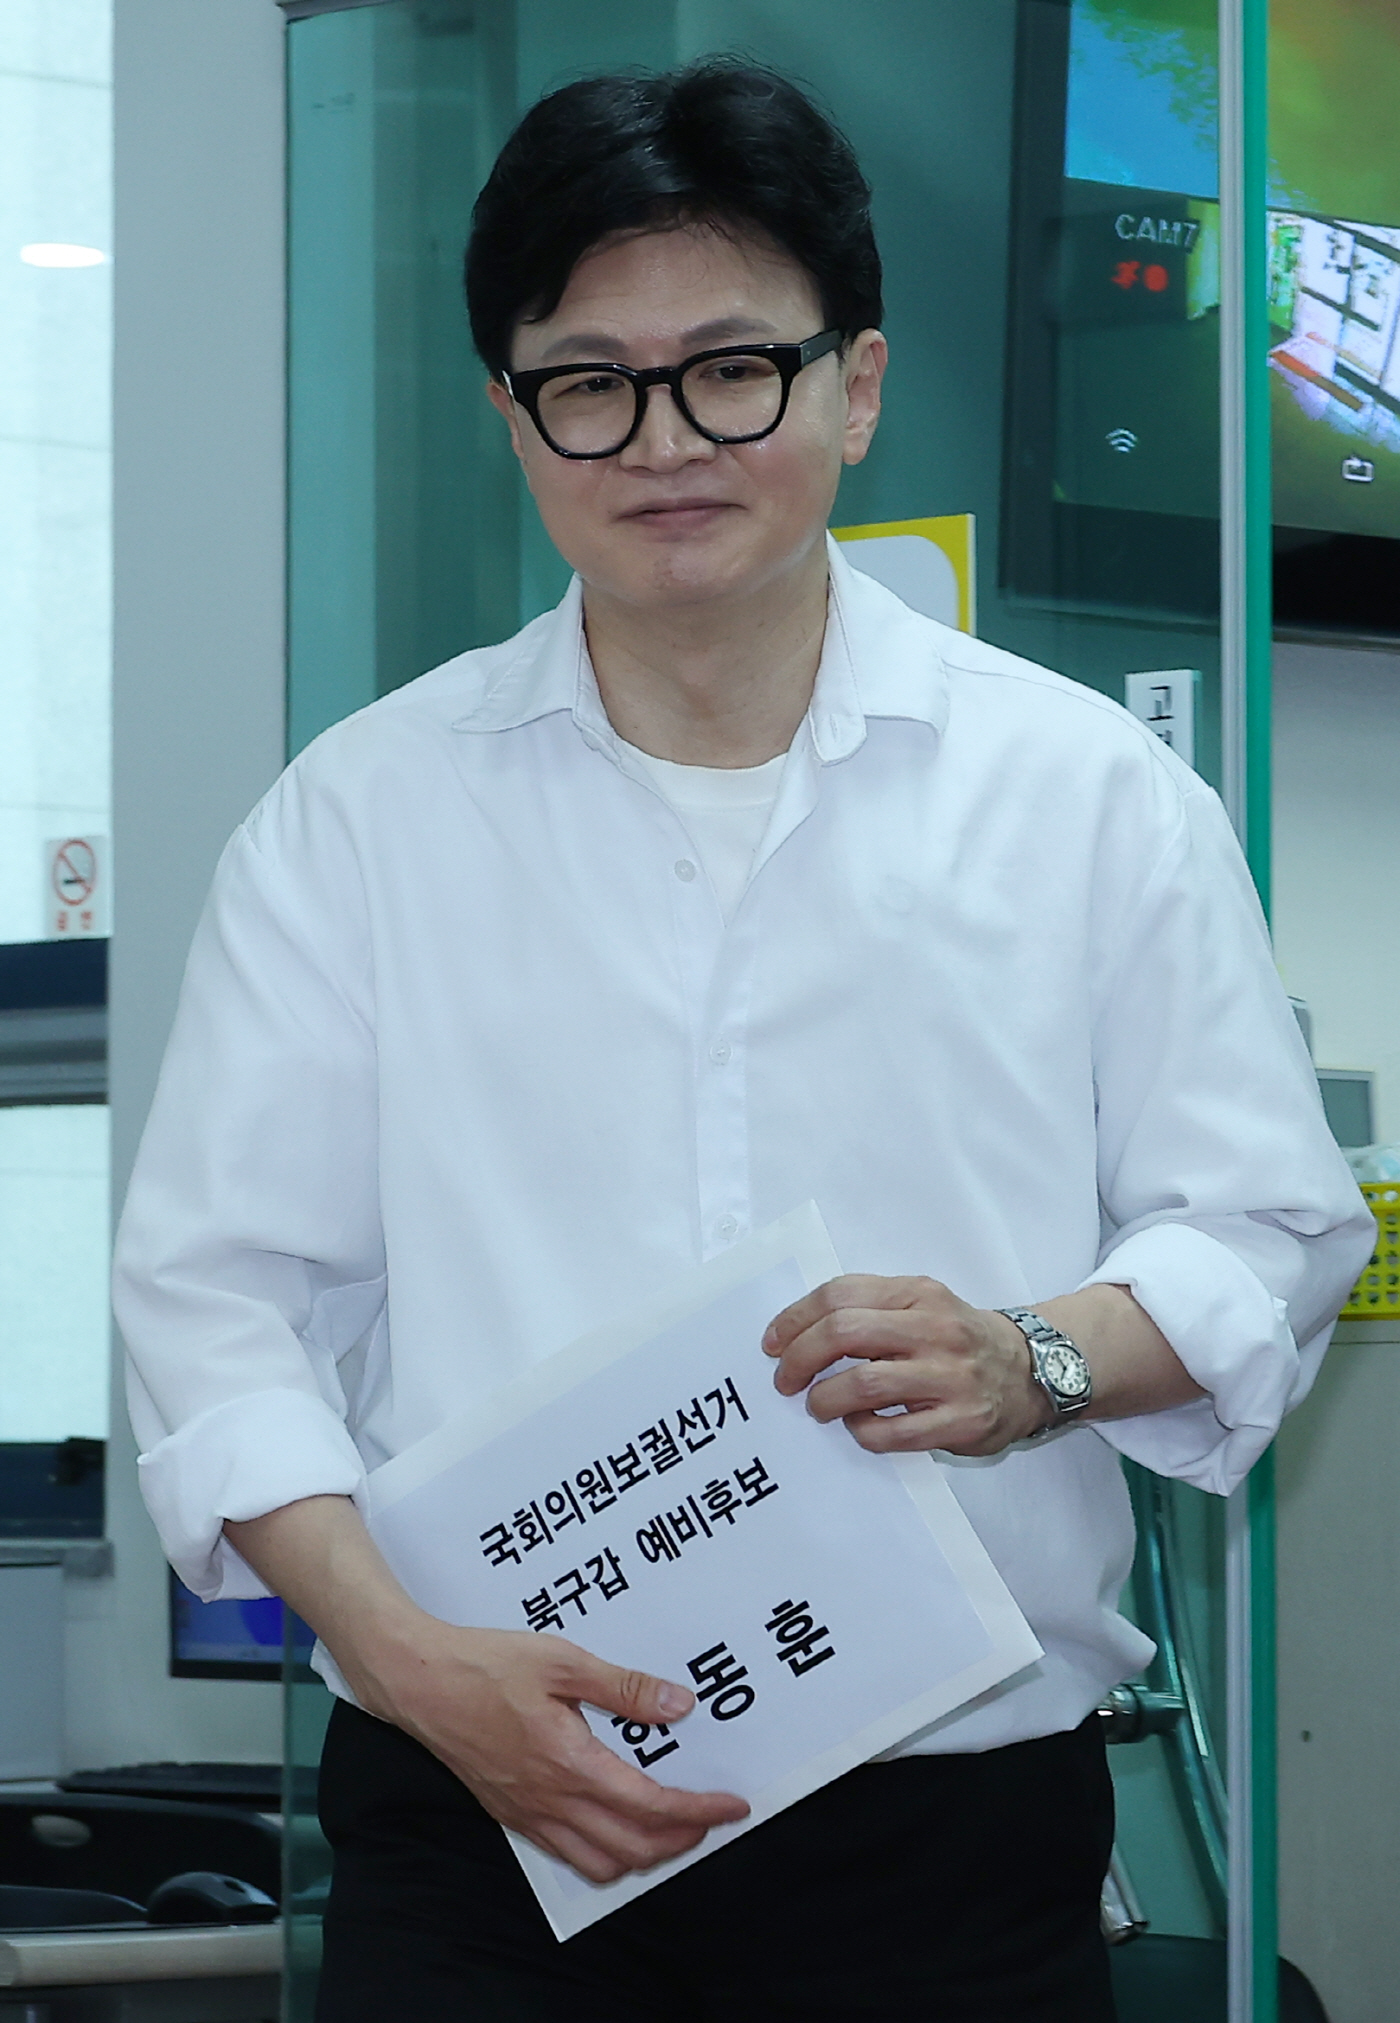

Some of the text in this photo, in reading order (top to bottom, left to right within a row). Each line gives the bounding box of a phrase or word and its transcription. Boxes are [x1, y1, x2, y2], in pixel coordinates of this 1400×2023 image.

[479, 1377, 750, 1567] 국회의원보궐선거
[521, 1456, 780, 1633] 북구갑 예비후보
